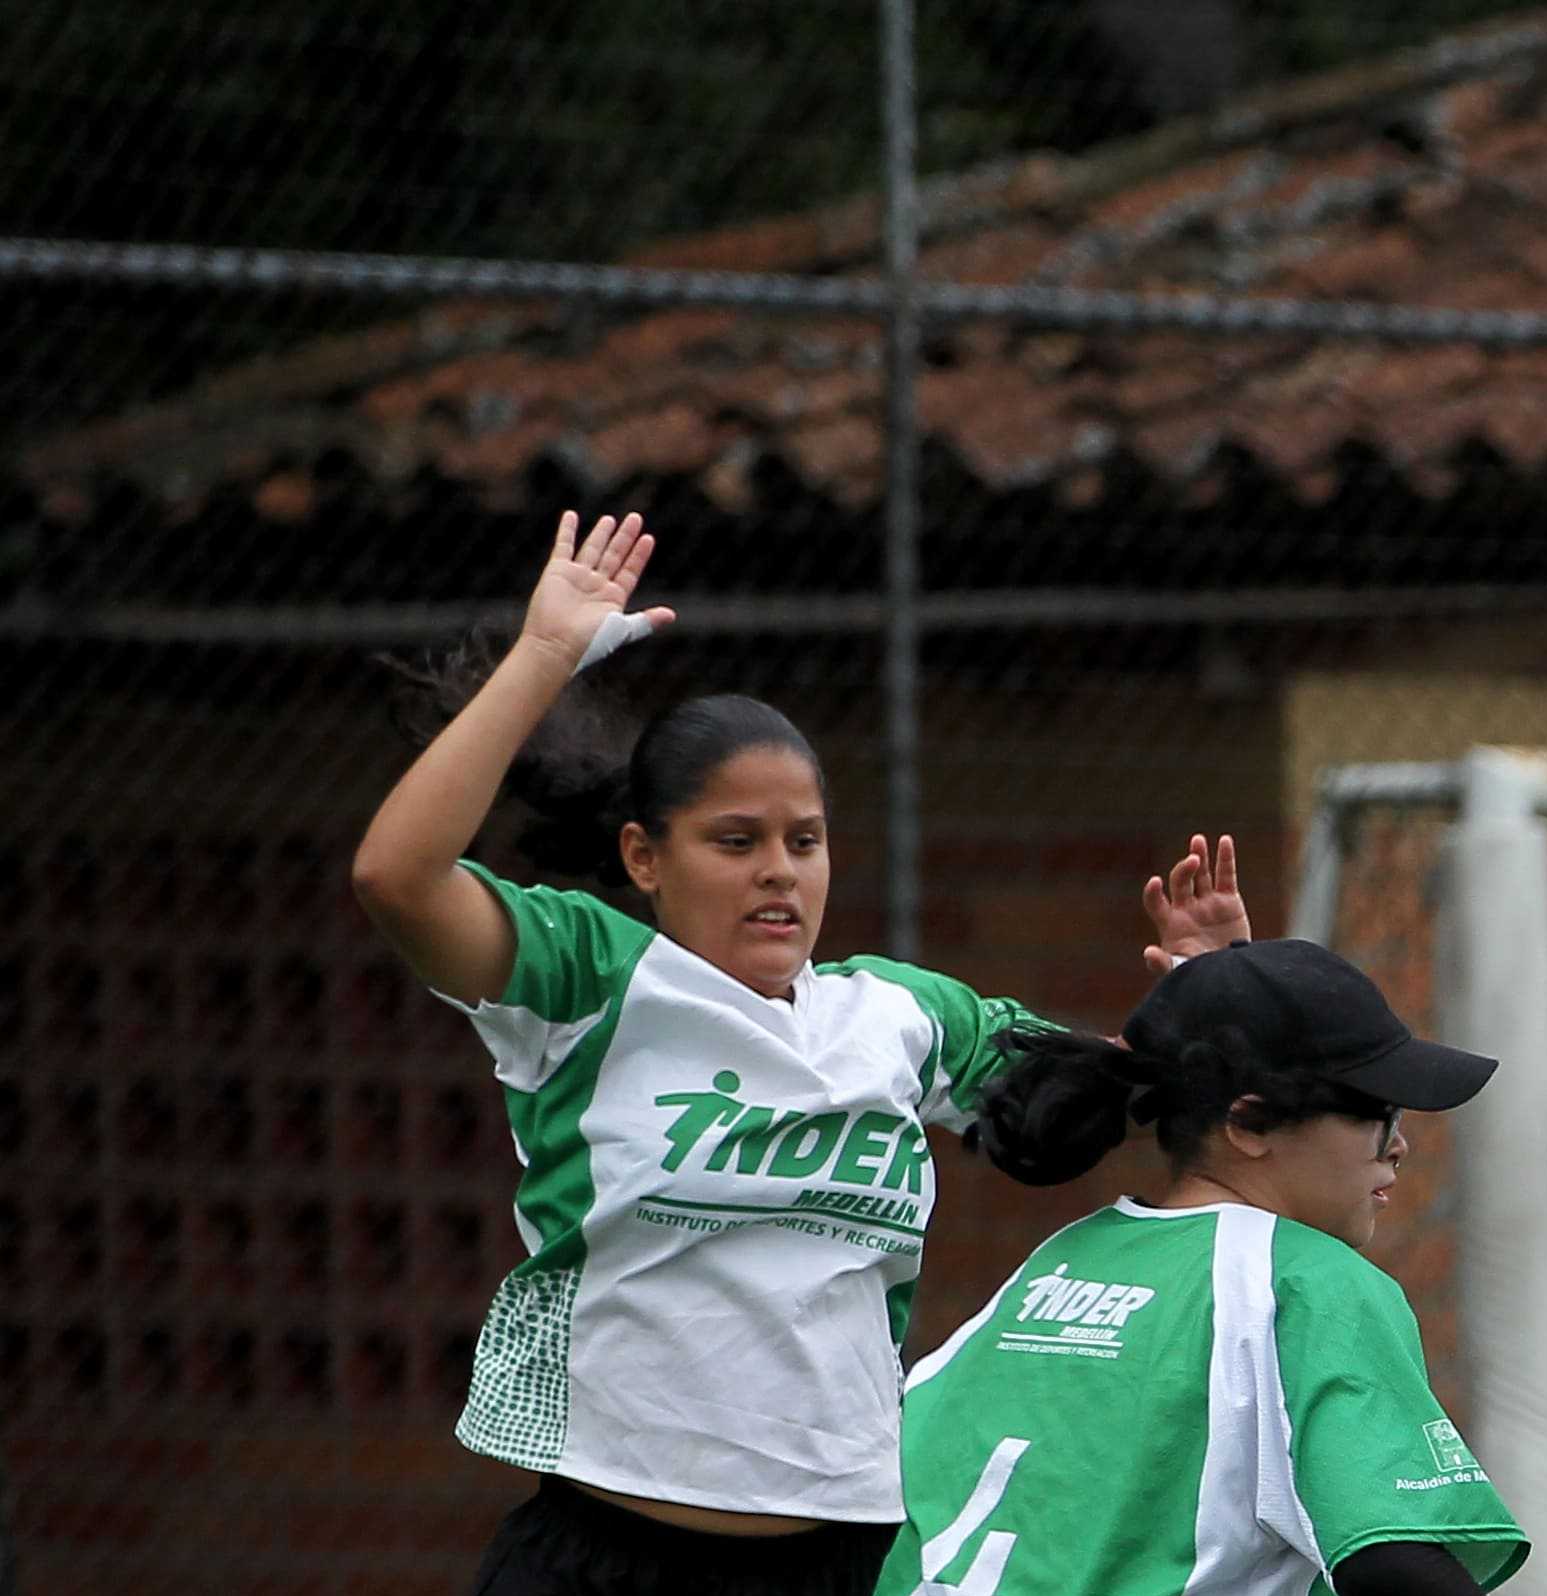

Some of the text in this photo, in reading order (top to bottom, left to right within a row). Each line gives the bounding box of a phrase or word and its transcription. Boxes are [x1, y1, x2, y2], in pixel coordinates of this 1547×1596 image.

[636, 1208, 723, 1232] INSTITUTO
[830, 1226, 843, 1240] Y
[792, 1189, 919, 1225] MEDELLÍN
[1016, 1263, 1155, 1327] INDER
[1453, 1472, 1472, 1483] de
